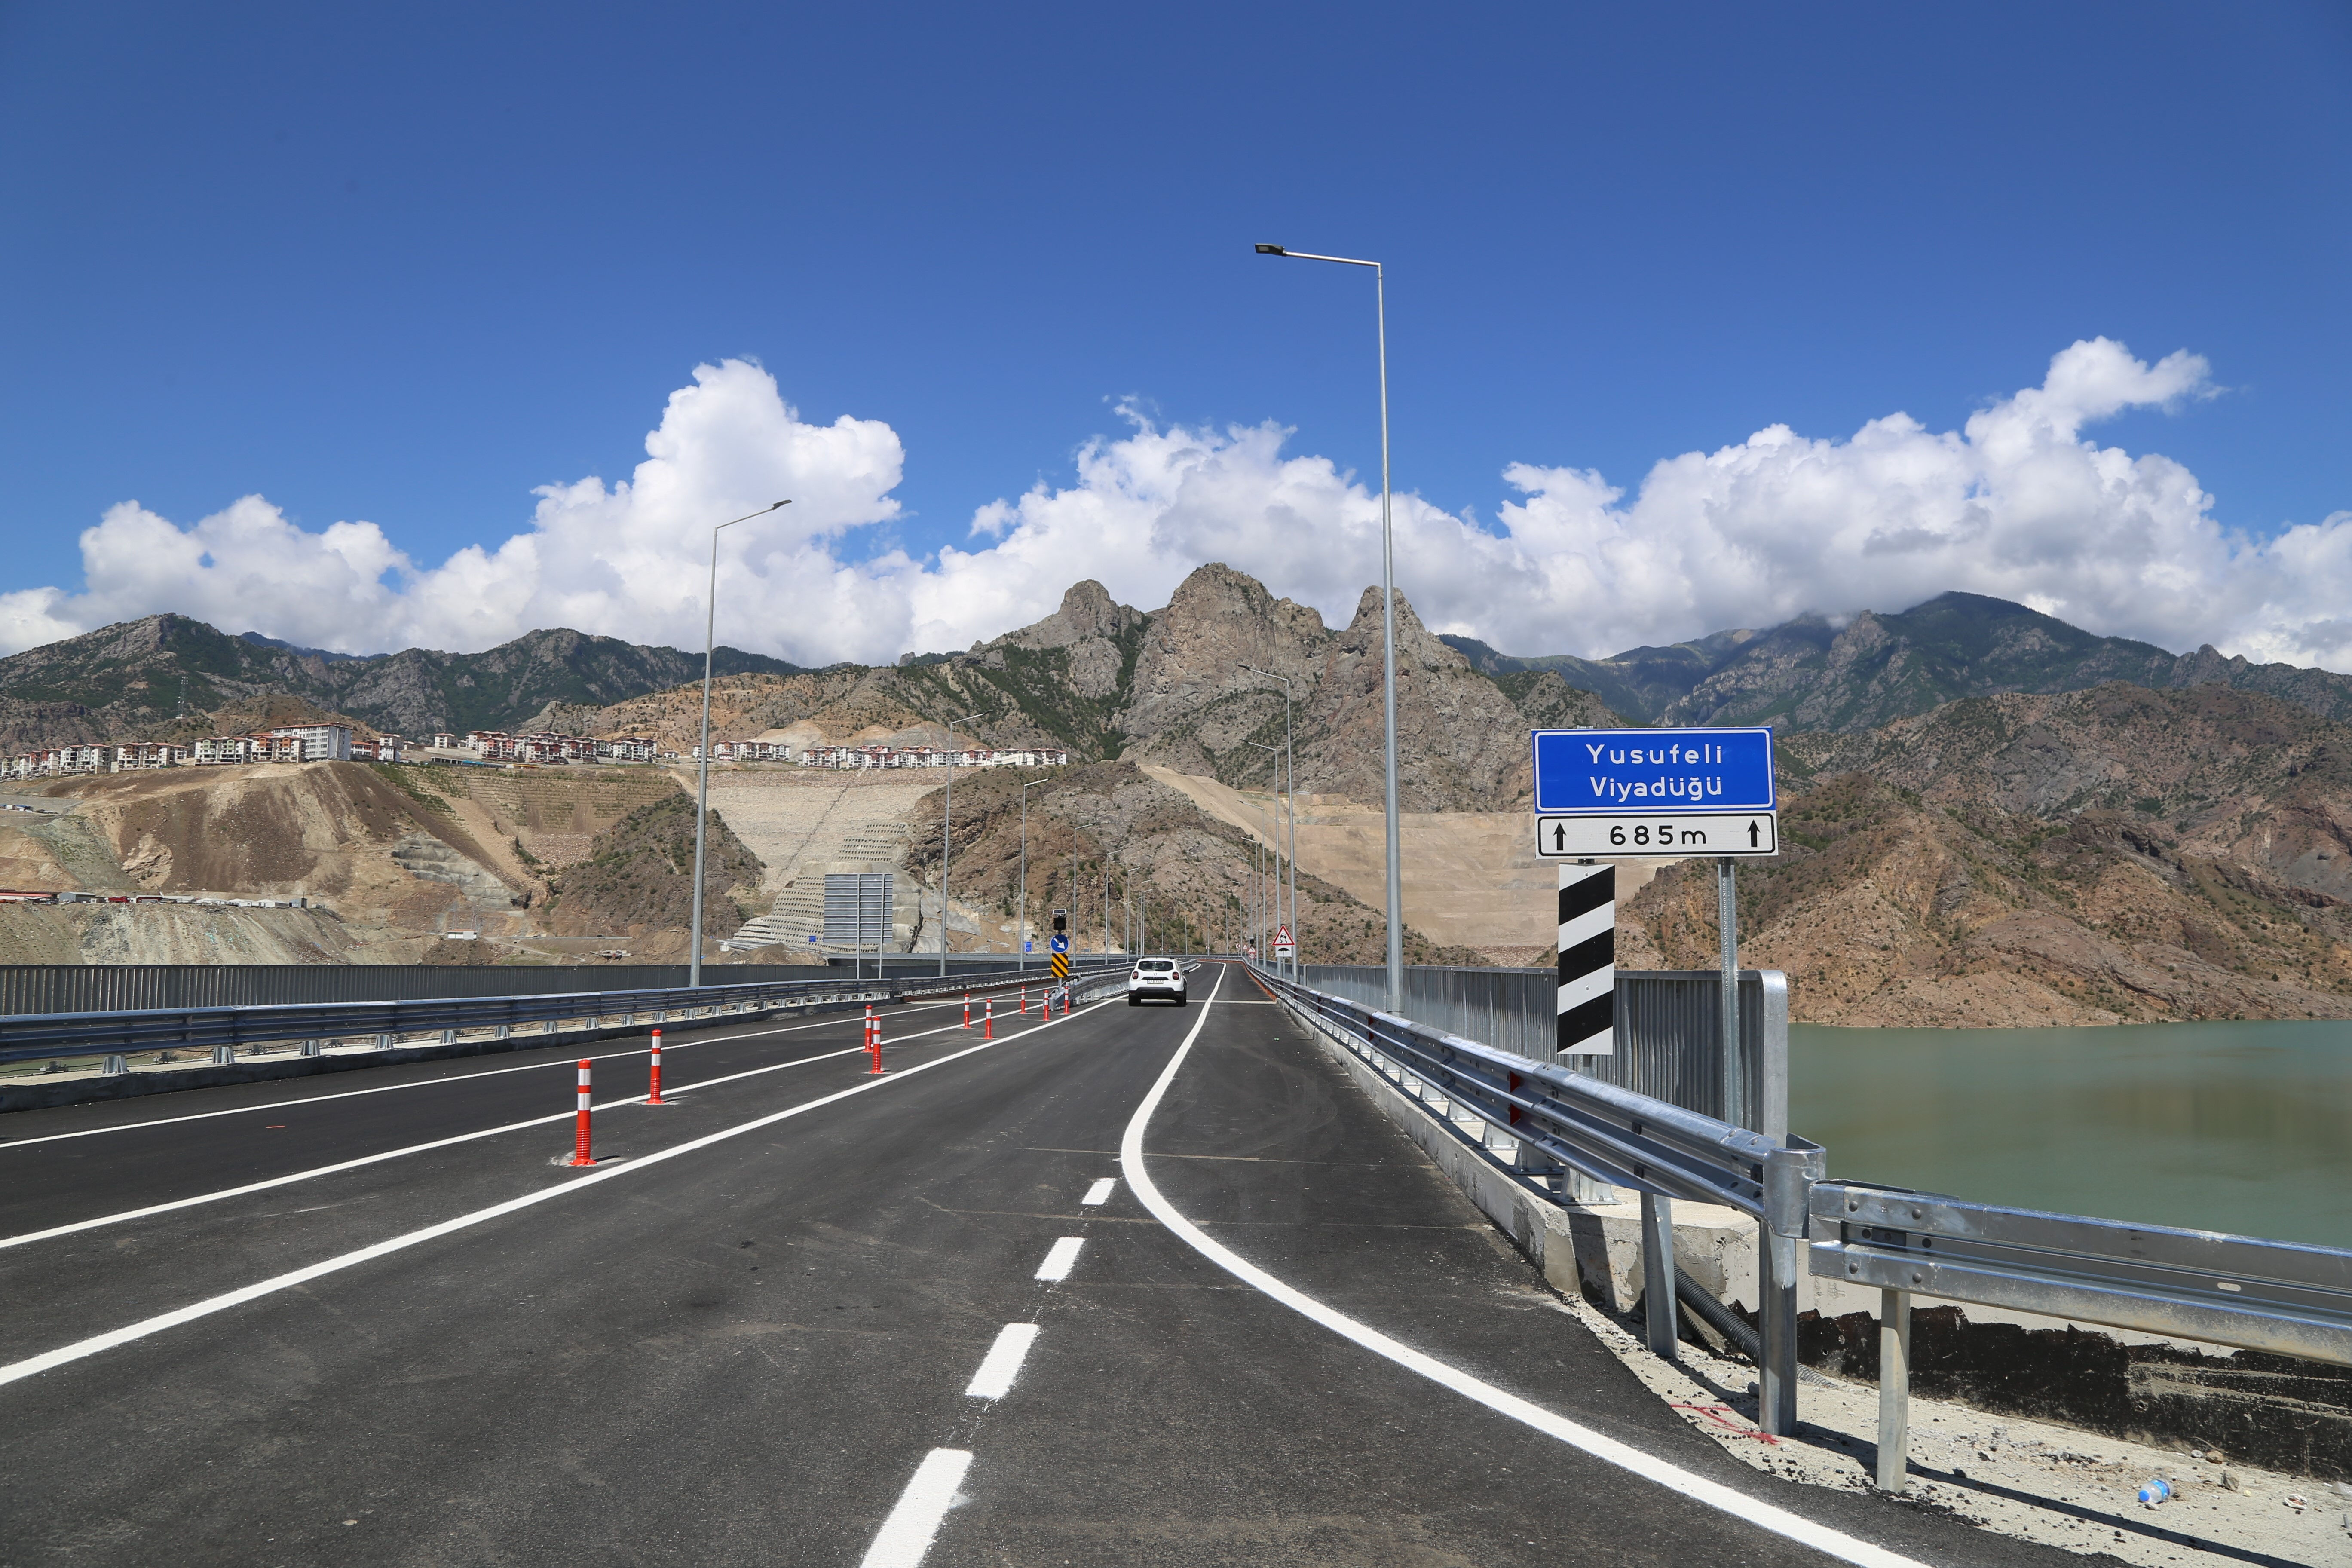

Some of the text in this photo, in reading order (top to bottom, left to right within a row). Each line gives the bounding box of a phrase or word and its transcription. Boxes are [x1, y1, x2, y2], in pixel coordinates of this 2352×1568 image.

[1586, 744, 1721, 764] Yusufeli
[1590, 777, 1721, 802] Viyadüğü
[1610, 826, 1706, 845] 685m
